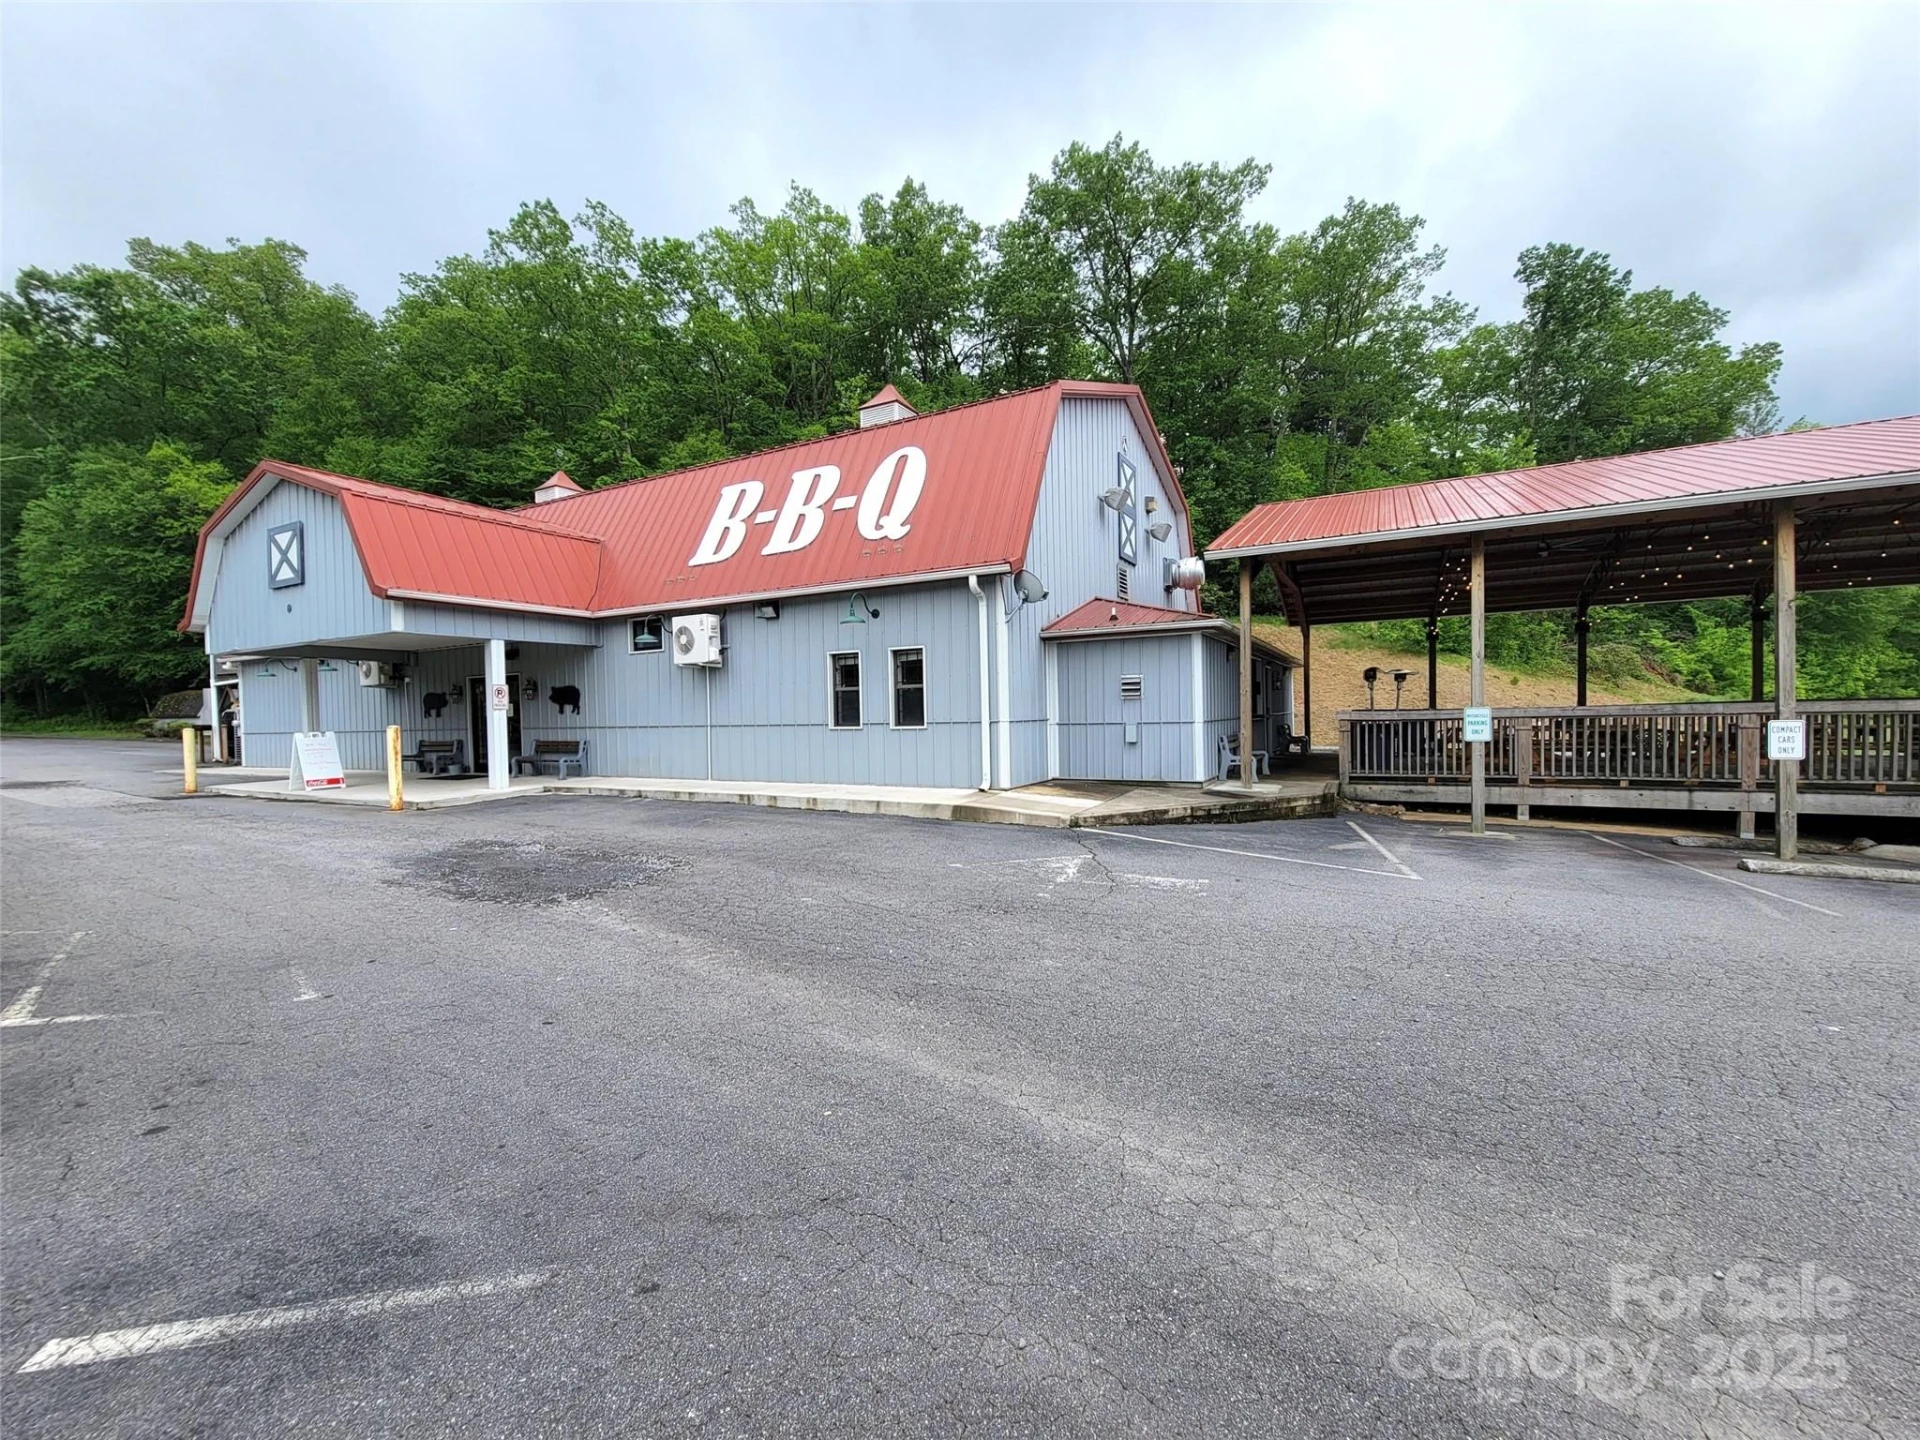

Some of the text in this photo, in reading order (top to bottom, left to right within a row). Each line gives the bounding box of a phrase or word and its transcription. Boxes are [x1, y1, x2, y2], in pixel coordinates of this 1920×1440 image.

[688, 445, 927, 567] B-B-Q
[1771, 725, 1801, 734] COMPACT
[1777, 735, 1796, 744] CARS
[1777, 746, 1796, 755] ONLY
